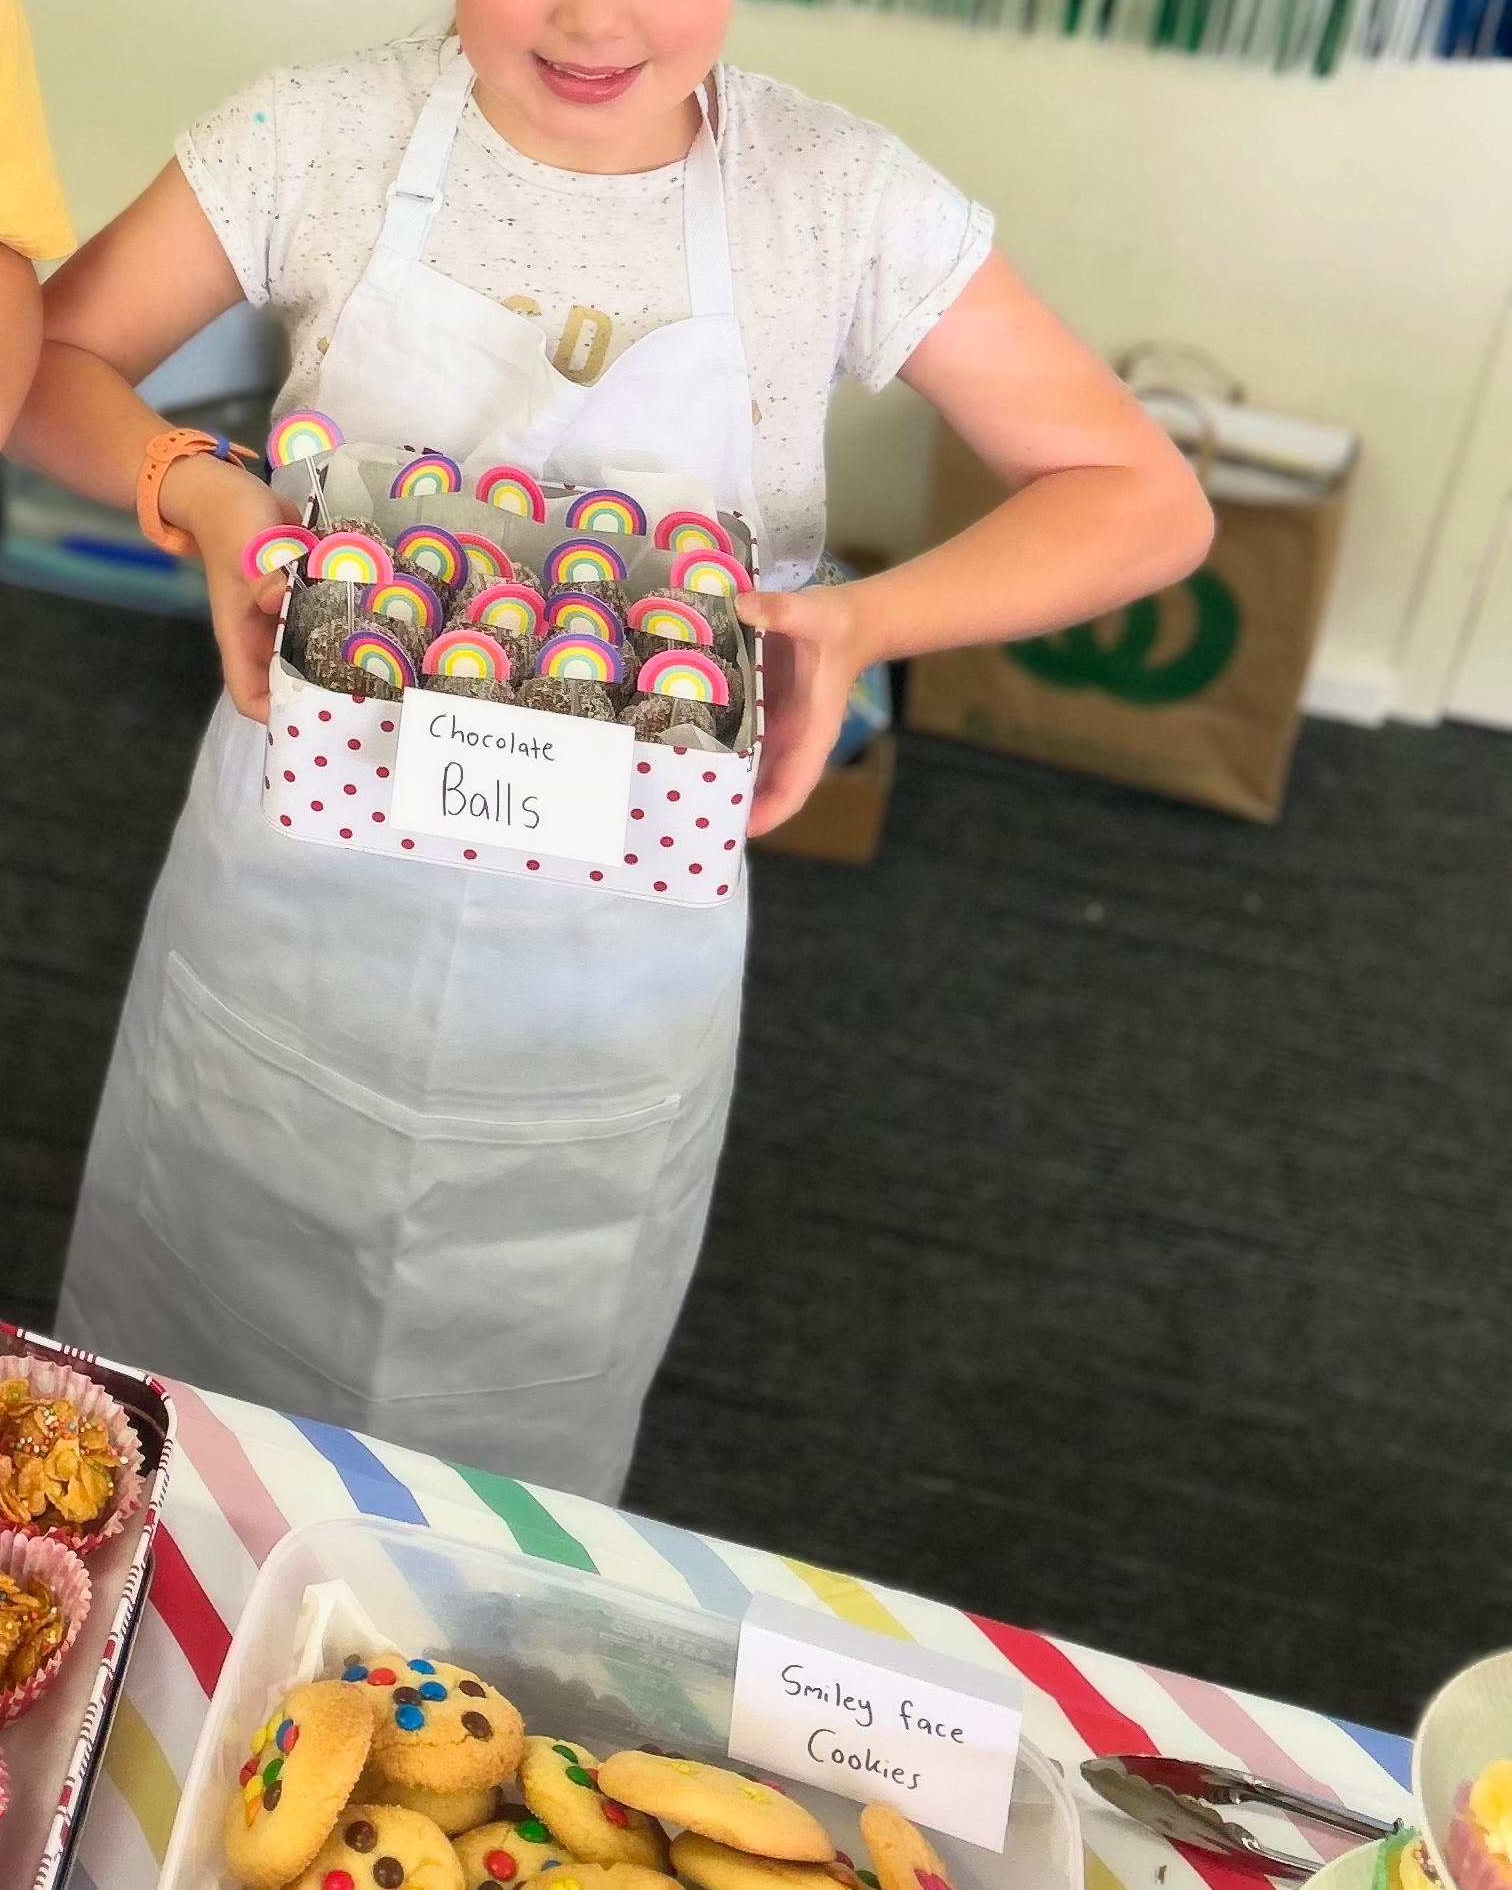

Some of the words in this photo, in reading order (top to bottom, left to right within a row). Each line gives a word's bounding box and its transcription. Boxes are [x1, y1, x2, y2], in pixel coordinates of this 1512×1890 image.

[429, 714, 555, 761] Chocolate
[442, 762, 540, 829] Balls
[781, 1664, 874, 1727] Smiley
[899, 1700, 965, 1744] face
[807, 1728, 922, 1790] Cookies
